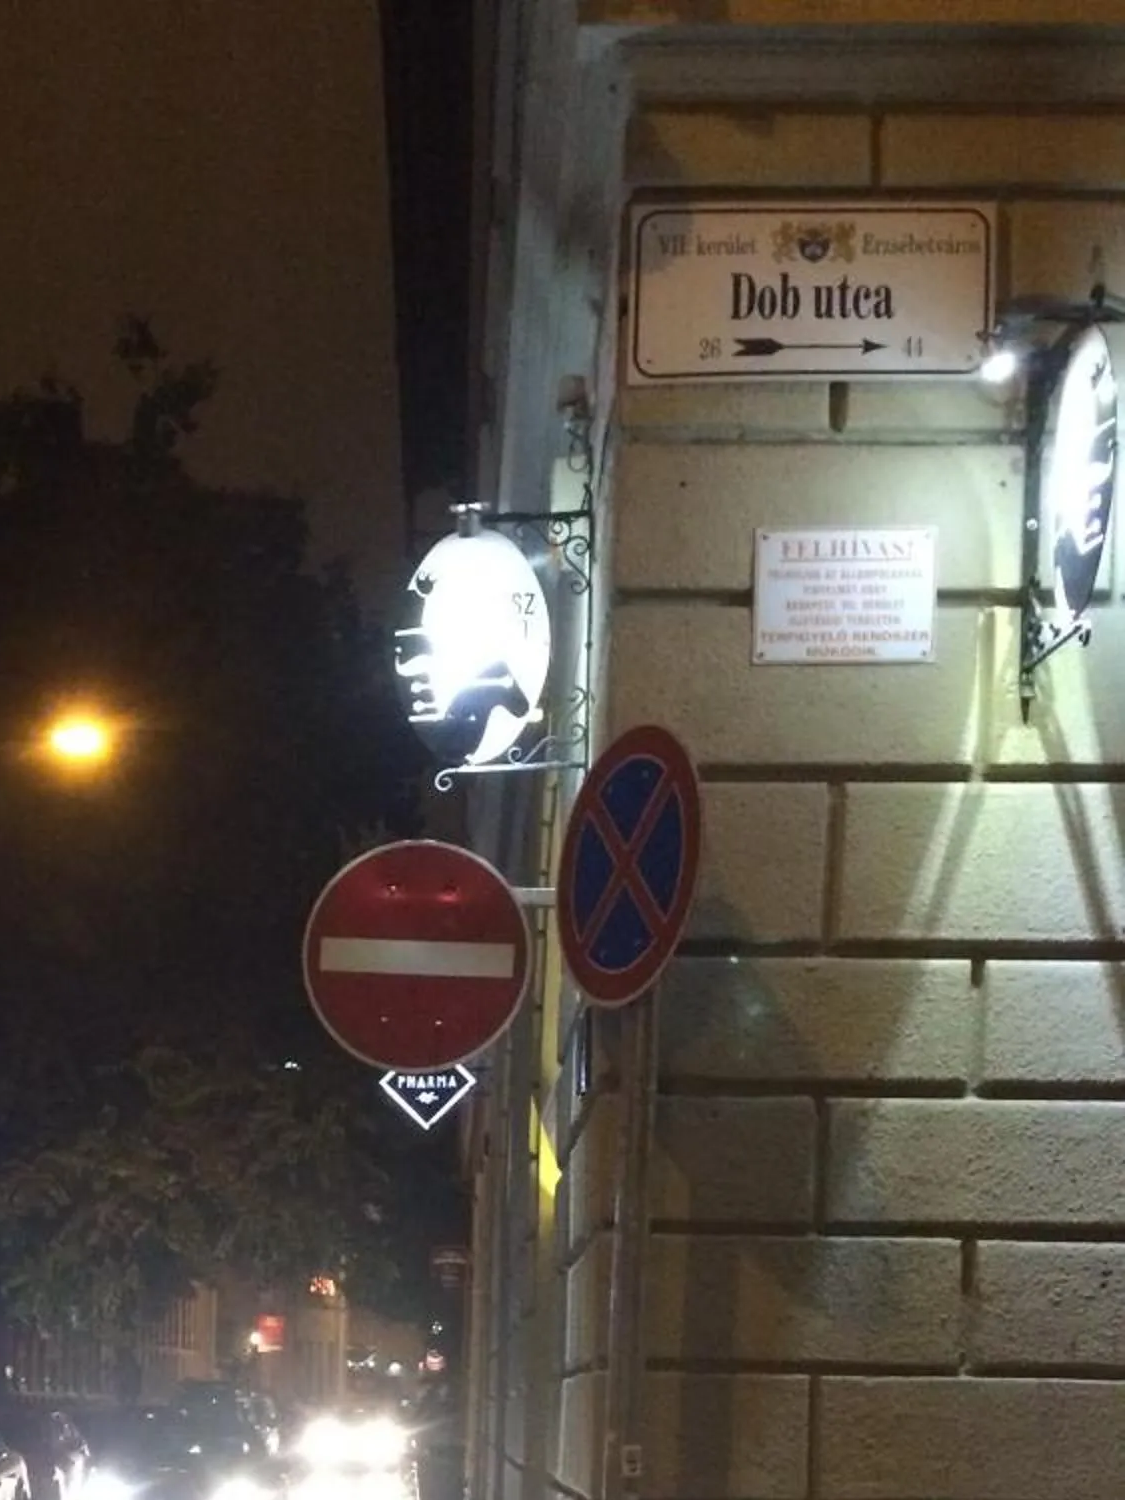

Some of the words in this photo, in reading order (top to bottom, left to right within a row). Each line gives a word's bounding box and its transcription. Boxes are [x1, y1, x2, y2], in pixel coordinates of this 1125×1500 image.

[730, 271, 800, 320] Dob
[813, 273, 895, 320] utca
[398, 1075, 457, 1089] PHARMA
